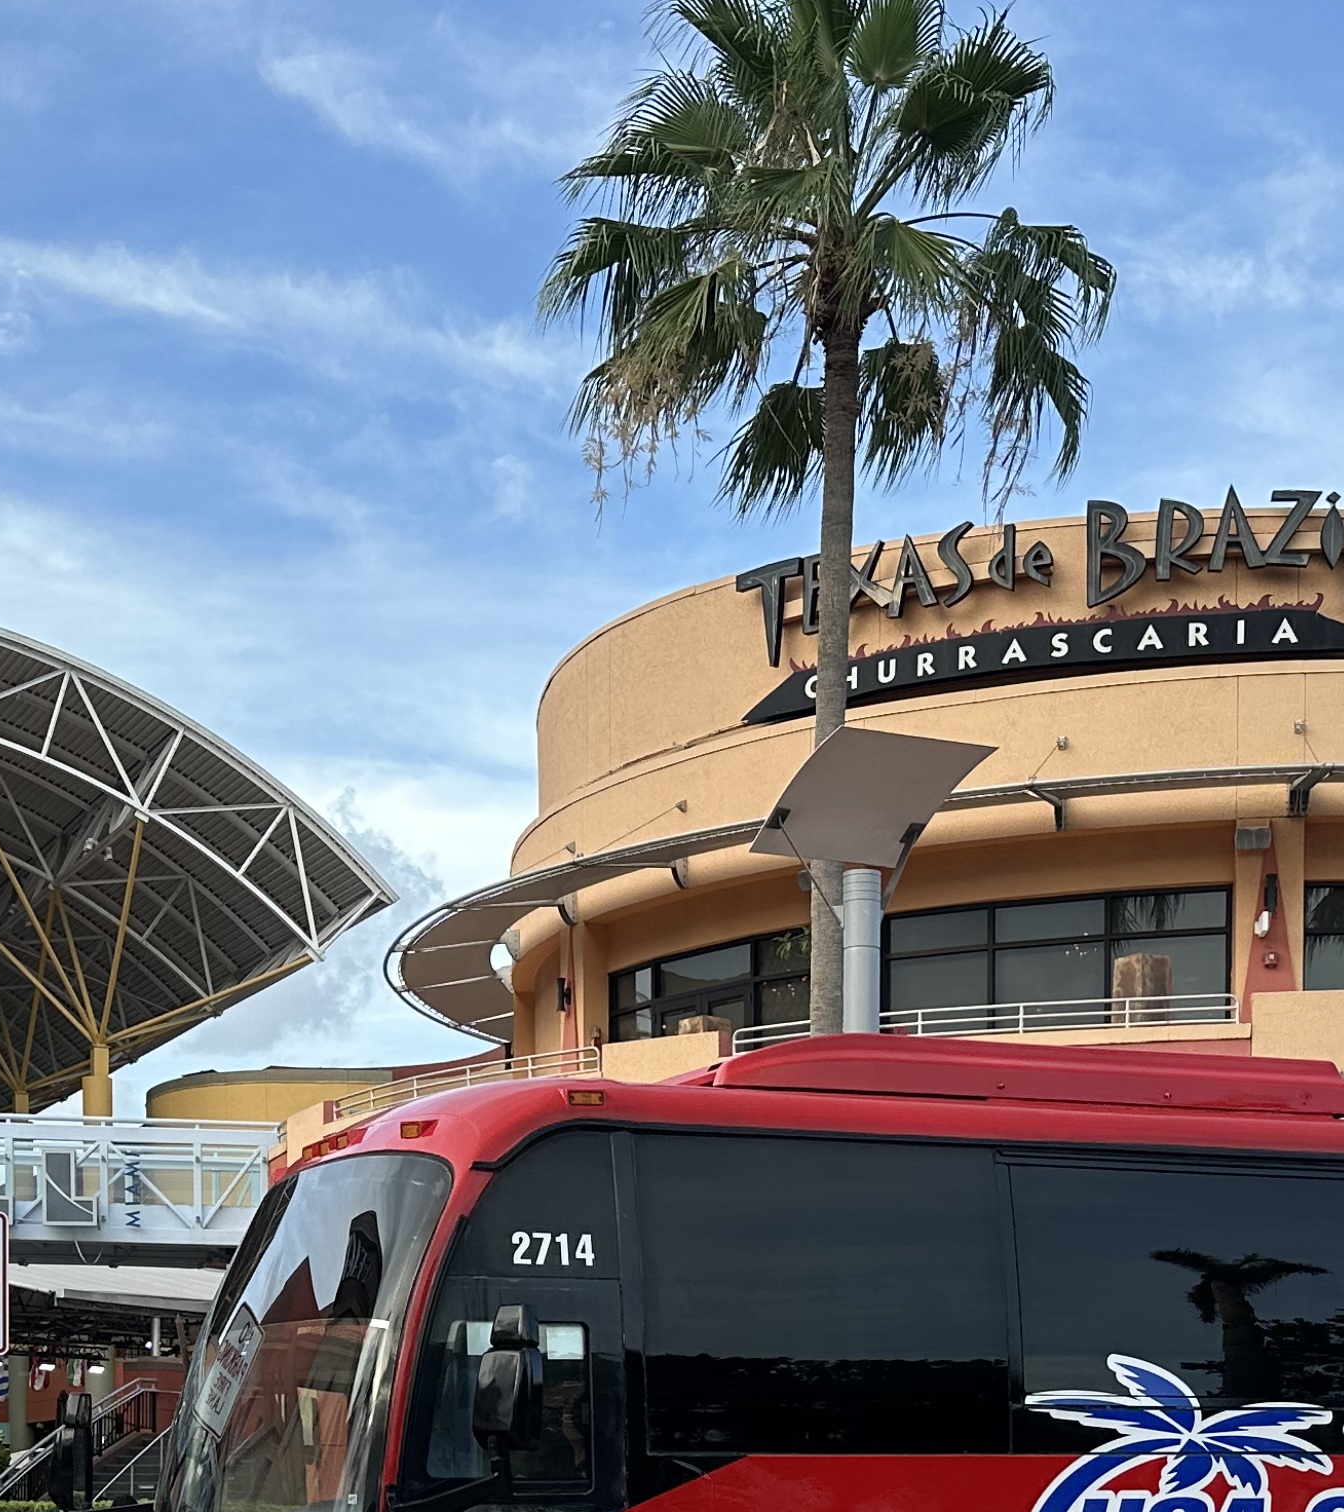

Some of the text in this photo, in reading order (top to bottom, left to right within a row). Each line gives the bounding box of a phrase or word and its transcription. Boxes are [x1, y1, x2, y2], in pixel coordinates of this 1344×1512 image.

[988, 523, 1054, 591] de
[804, 618, 1298, 700] CHURRASCARIA
[124, 1152, 141, 1228] MIAMI
[511, 1231, 595, 1267] 2714
